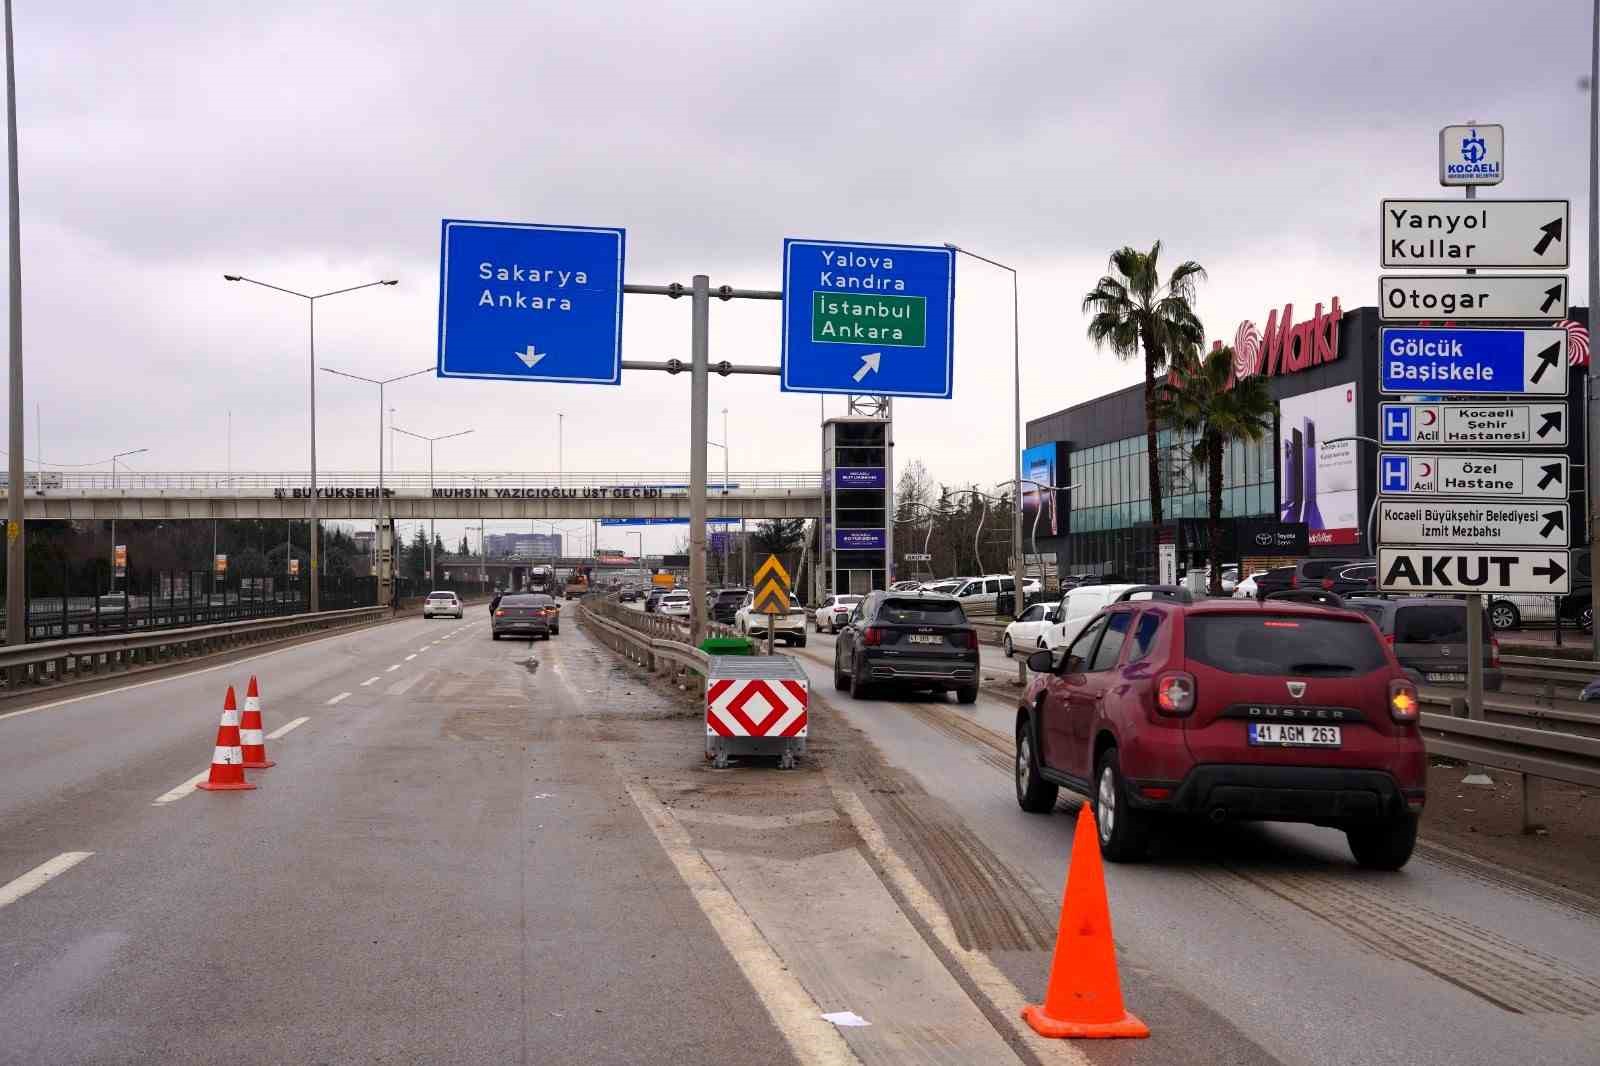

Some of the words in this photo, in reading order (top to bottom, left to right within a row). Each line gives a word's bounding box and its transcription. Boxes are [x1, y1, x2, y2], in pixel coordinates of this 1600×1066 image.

[1390, 210, 1486, 234] Yanyol
[1391, 239, 1476, 258] Kullar
[821, 251, 893, 269] Yalova
[479, 262, 588, 288] Sakarya
[821, 271, 905, 291] Kandıra
[478, 289, 572, 311] Ankara
[821, 295, 911, 319] İstanbul
[1388, 288, 1490, 314] Otogar
[821, 321, 903, 340] Ankara
[1255, 296, 1343, 376] Markt
[1390, 338, 1463, 357] Gölcük
[1390, 361, 1494, 382] Başiskele
[1459, 409, 1514, 418] Kocaeli
[1387, 412, 1408, 437] H
[1467, 420, 1508, 430] Şehir
[1417, 431, 1438, 441] Acil
[1448, 431, 1526, 440] Hastanesi
[1385, 461, 1406, 486] H
[1462, 462, 1497, 474] Özel
[1414, 481, 1433, 491] Acil
[1445, 478, 1514, 489] Hastane
[1384, 509, 1422, 521] Kocaeli
[1425, 509, 1484, 524] Büyükşehir
[1486, 510, 1539, 525] Belediyesi
[1422, 524, 1449, 537] İzmit
[1382, 555, 1519, 587] AKUT
[1249, 707, 1344, 718] DUSTER
[1257, 727, 1272, 741] 41
[1279, 728, 1305, 742] AGM
[1312, 728, 1337, 742] 263
